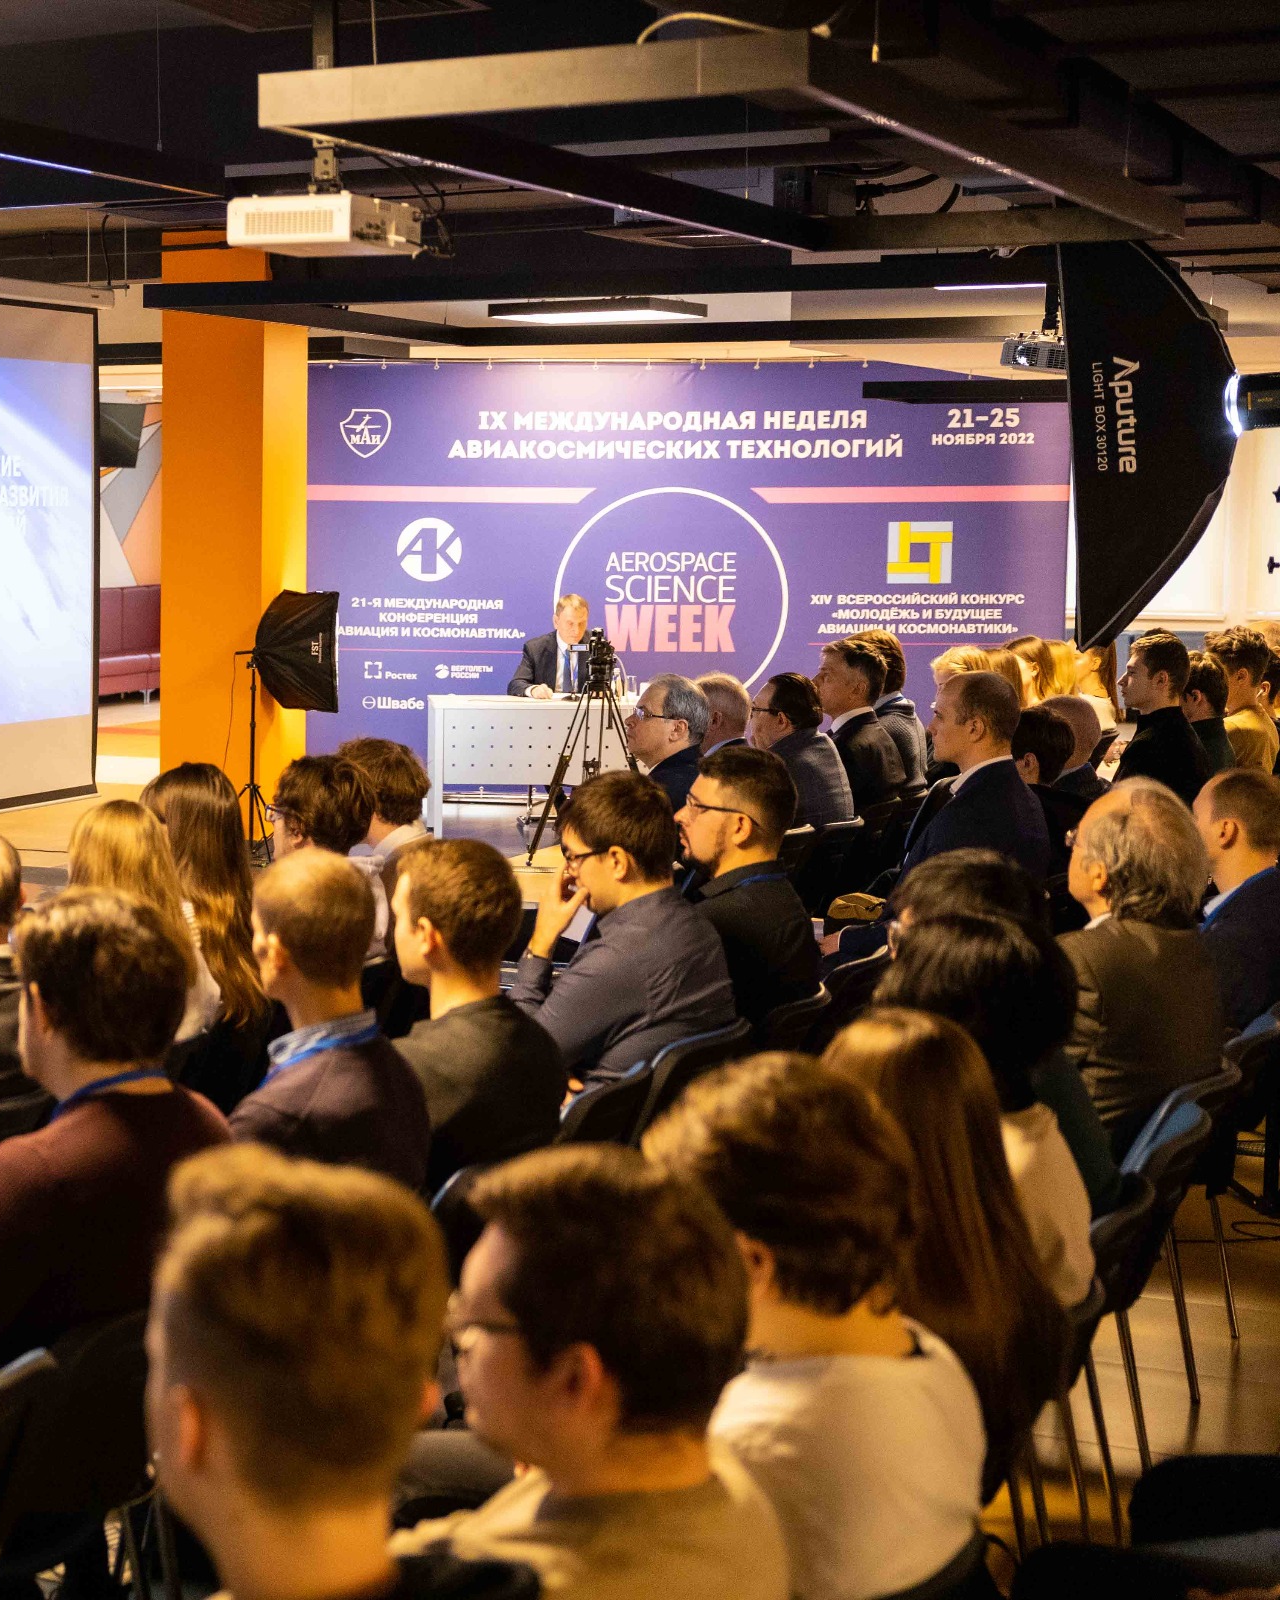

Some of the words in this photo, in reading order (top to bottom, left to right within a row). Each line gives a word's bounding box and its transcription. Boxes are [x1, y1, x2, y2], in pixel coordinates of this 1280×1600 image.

[1092, 362, 1104, 400] LIGHT
[513, 410, 756, 432] МЕЖДУНАРОДНАЯ
[763, 410, 867, 431] НЕДЕЛЯ
[1094, 405, 1106, 433] BOX
[931, 434, 996, 446] НОЯБРЯ
[999, 432, 1035, 445] 2022
[447, 439, 721, 460] АВИАКОСМИЧЕСКИХ
[726, 433, 904, 459] ТЕХНОЛОГИЙ
[1096, 434, 1108, 471] 30120
[605, 552, 737, 572] AEROSPACE
[605, 575, 736, 603] SCIENCE
[351, 597, 382, 609] 21-Я
[384, 598, 504, 611] МЕЖДУНАРОДНАЯ
[837, 592, 959, 605] ВСЕРОССИЙСКИЙ
[961, 594, 1025, 605] КОНКУРС
[379, 612, 478, 625] КОНФЕРЕНЦИЯ
[922, 609, 932, 620] И
[935, 609, 1003, 621] БУДУЩЕЕ
[401, 627, 410, 637] И
[605, 604, 736, 653] WEEK
[887, 624, 896, 634] И
[385, 670, 418, 681] Ростех
[450, 664, 494, 673] ВЕРТОЛЕТЫ
[377, 695, 425, 710] Швабе
